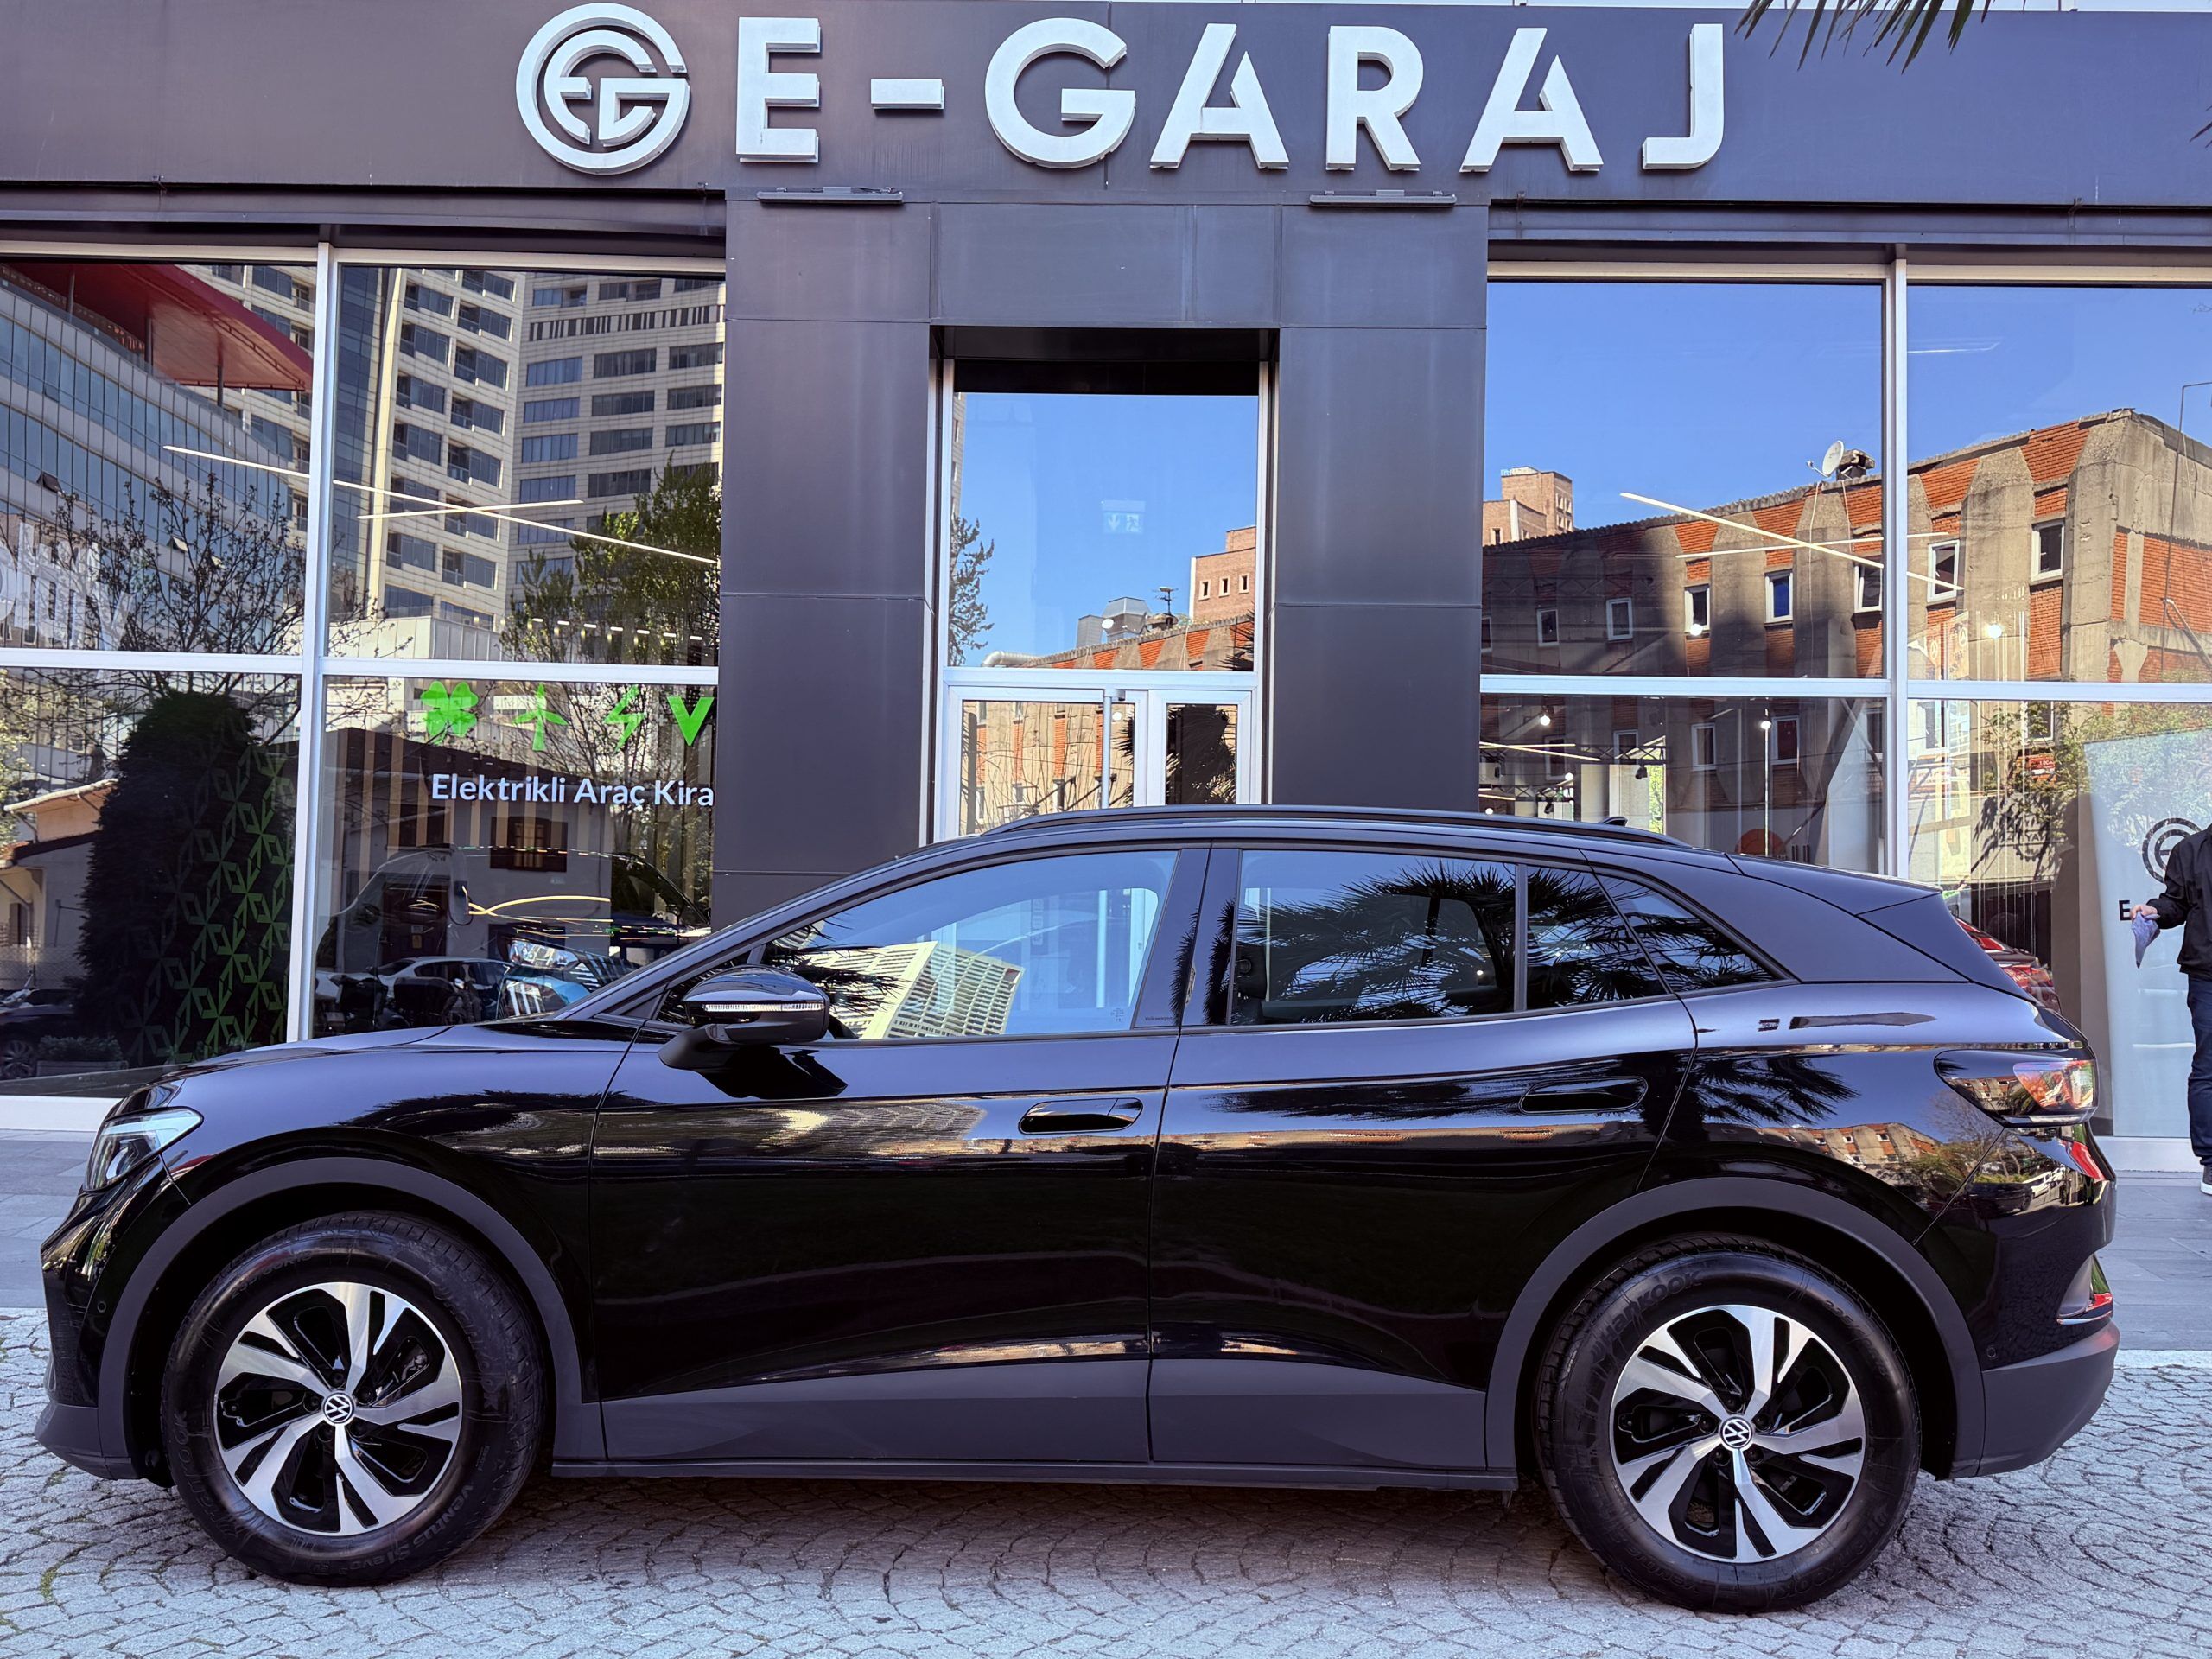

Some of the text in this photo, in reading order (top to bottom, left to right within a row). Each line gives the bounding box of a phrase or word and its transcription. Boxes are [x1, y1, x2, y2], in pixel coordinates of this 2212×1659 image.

[736, 16, 1725, 173] E-GARAJ
[432, 773, 715, 807] Elektrikli Araç Kira
